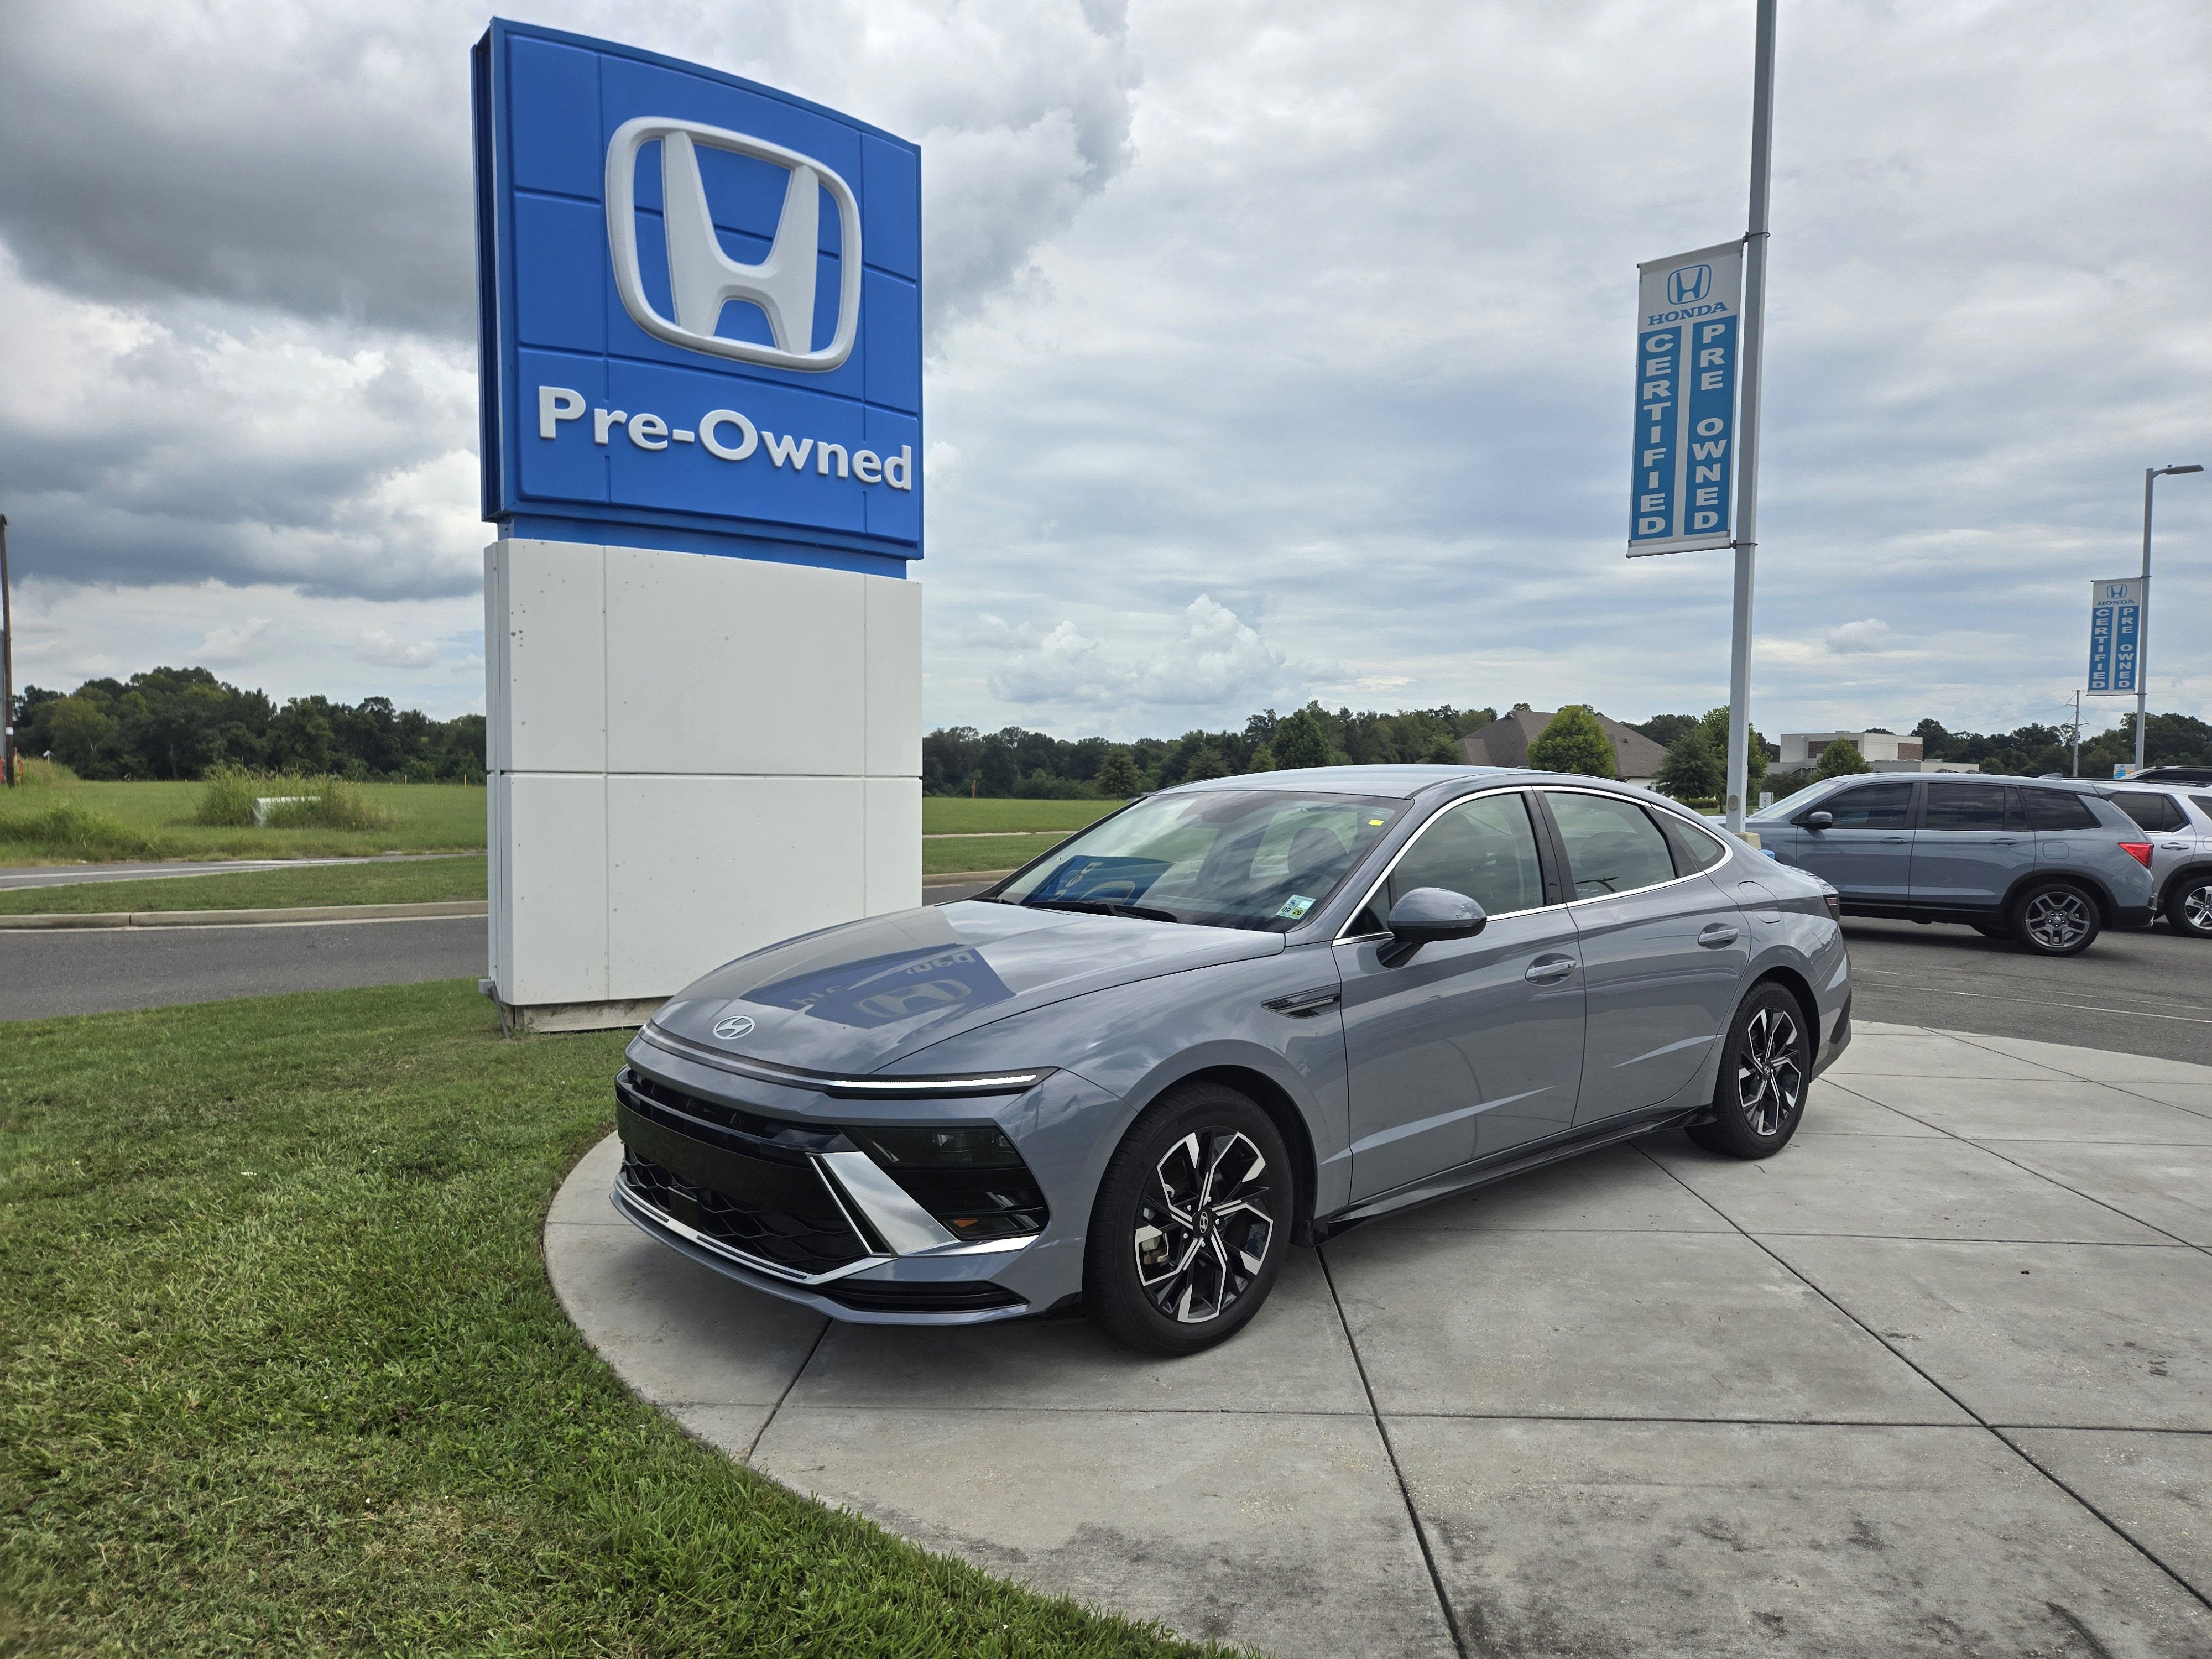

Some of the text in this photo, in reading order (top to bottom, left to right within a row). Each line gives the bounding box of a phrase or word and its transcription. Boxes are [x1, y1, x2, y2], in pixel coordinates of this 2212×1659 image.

[1647, 301, 1729, 326] HONDA
[538, 385, 912, 491] Pre-Owned
[1638, 333, 1674, 535] CERTIFIED
[1692, 324, 1728, 529] PRE OWNED
[2091, 609, 2110, 688] CERTIFIED
[2117, 608, 2134, 688] PRE OWNED
